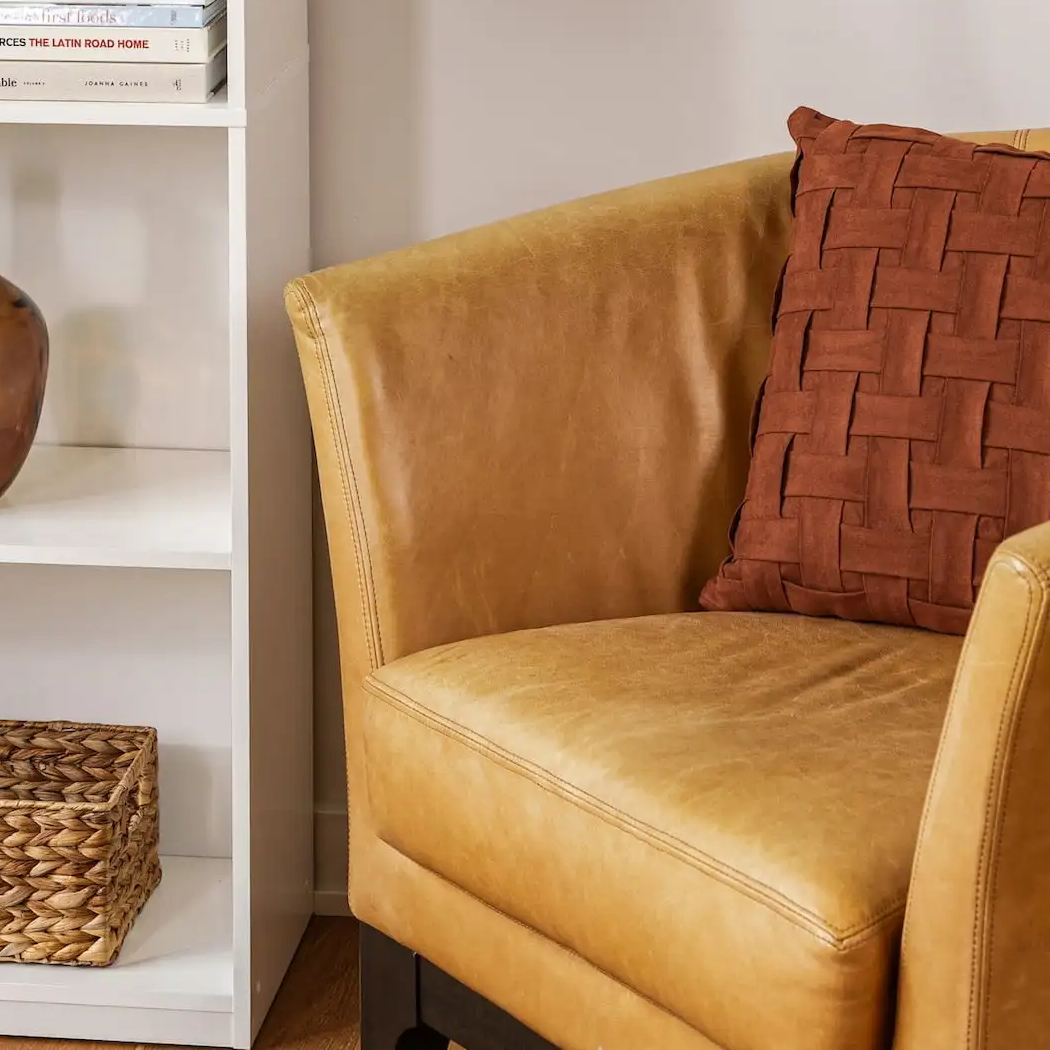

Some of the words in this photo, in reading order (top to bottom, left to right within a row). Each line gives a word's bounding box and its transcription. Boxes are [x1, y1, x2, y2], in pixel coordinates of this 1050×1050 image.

[41, 7, 71, 24] first
[77, 8, 118, 25] foods
[29, 37, 50, 48] THE
[52, 38, 82, 49] LATIN
[84, 39, 115, 49] ROAD
[117, 39, 150, 50] HOME
[118, 80, 149, 88] GAINES
